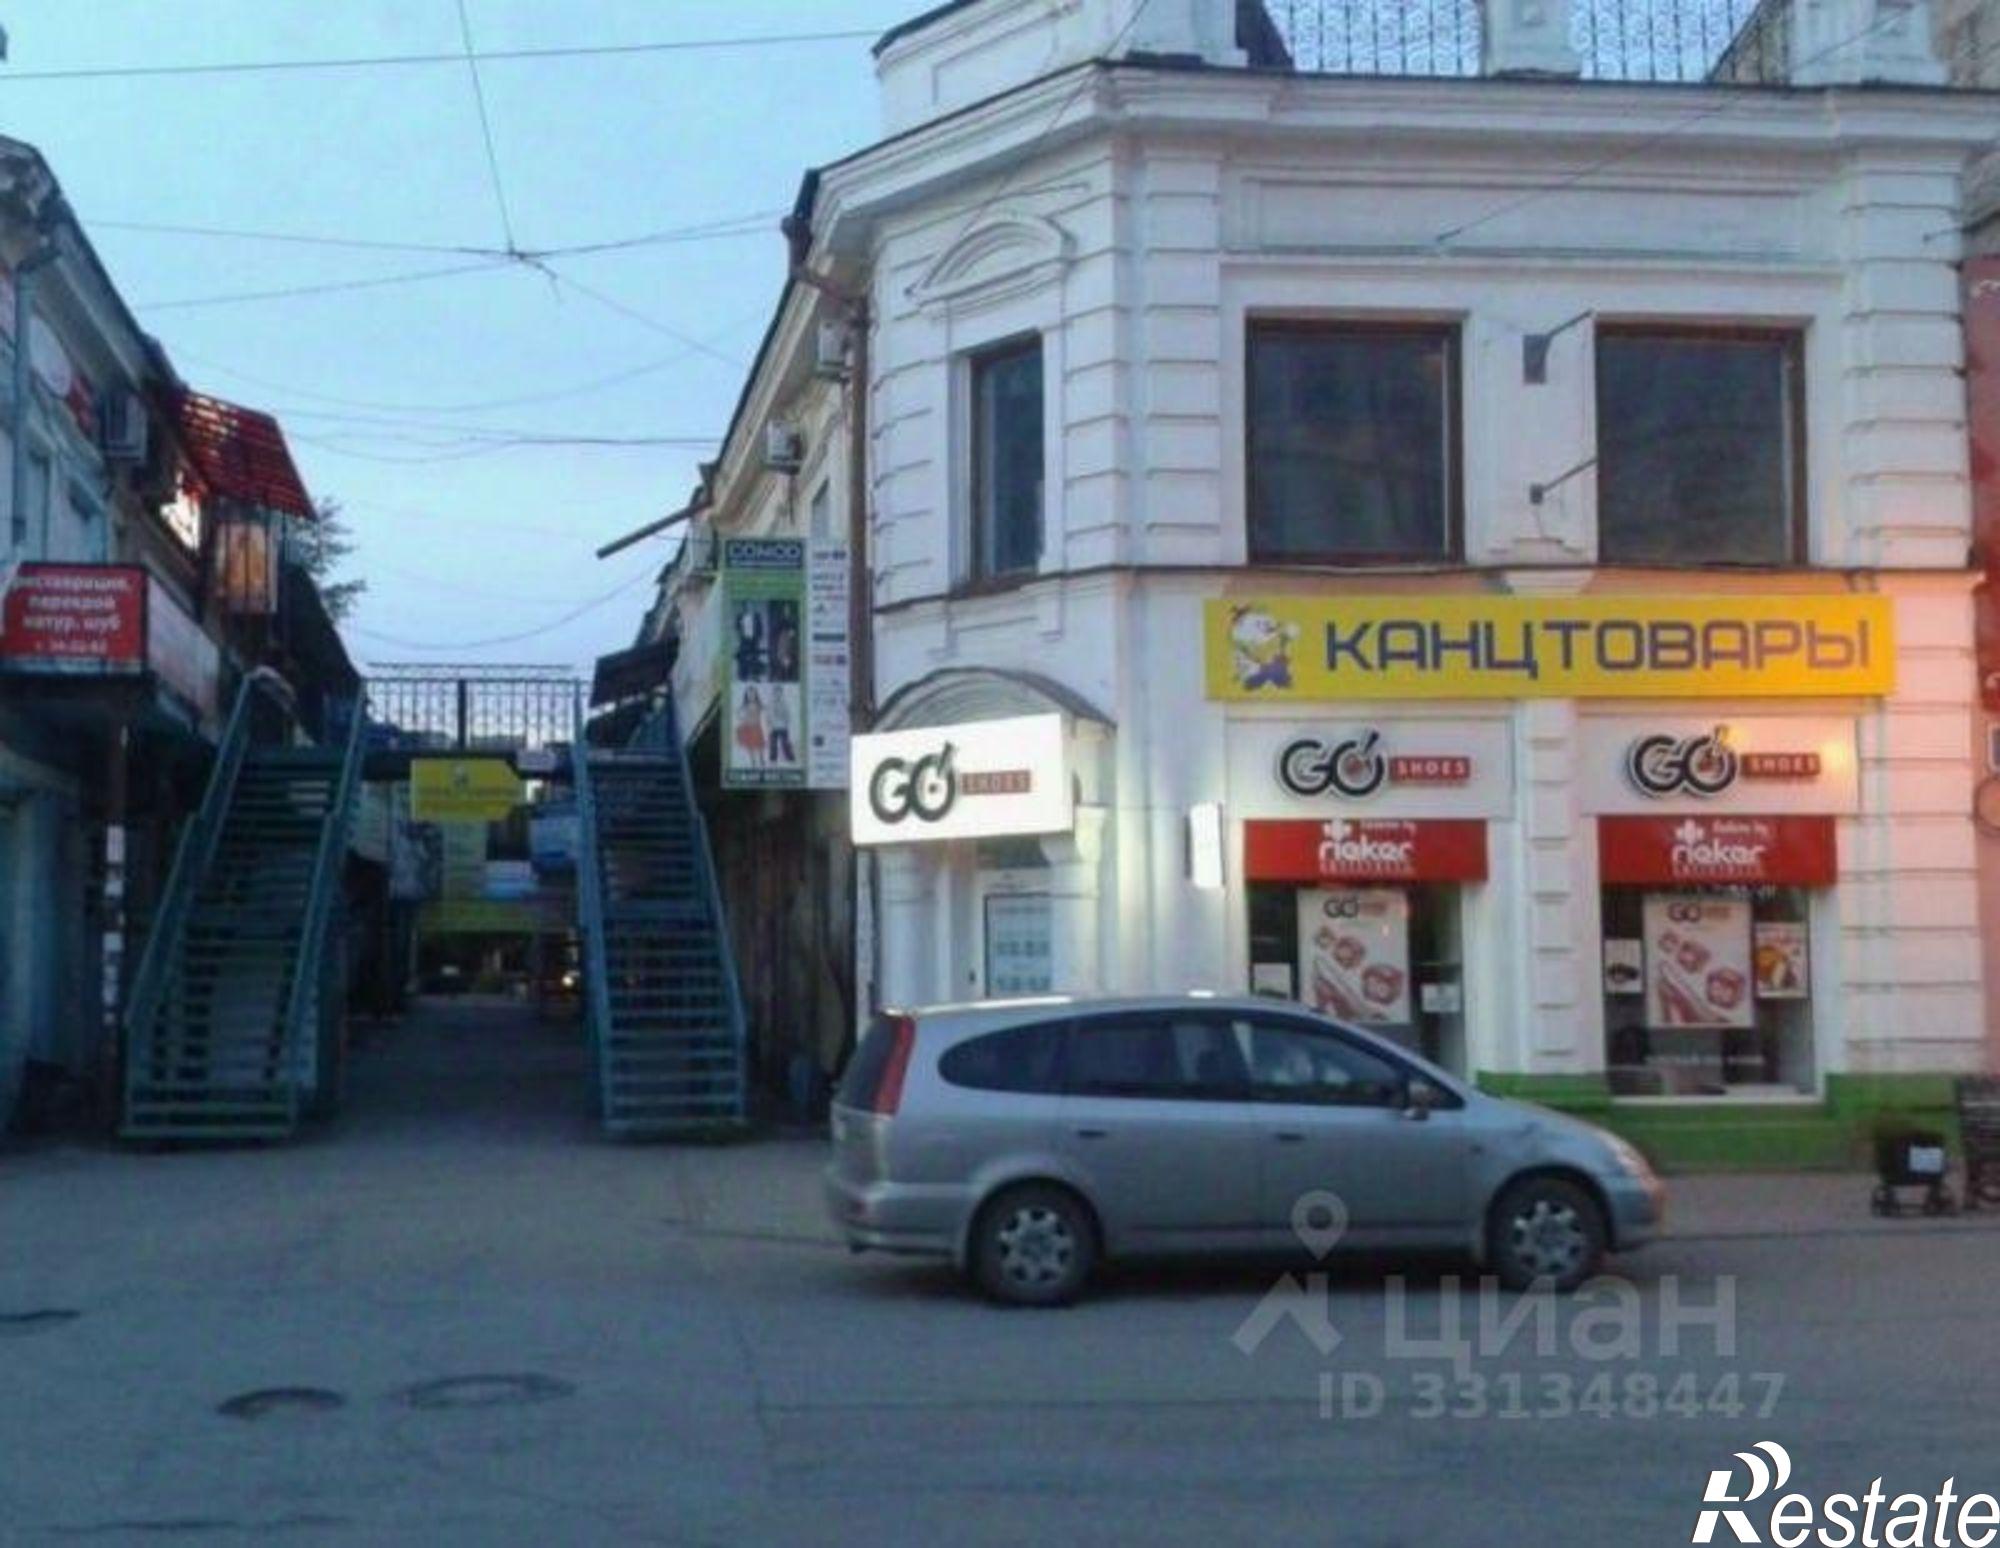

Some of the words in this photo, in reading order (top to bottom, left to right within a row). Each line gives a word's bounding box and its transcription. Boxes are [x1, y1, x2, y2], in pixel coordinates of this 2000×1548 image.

[1326, 620, 1869, 678] КАНЦТОВАРЫ
[1396, 759, 1467, 777] SHOES
[1751, 758, 1818, 774] SHOES
